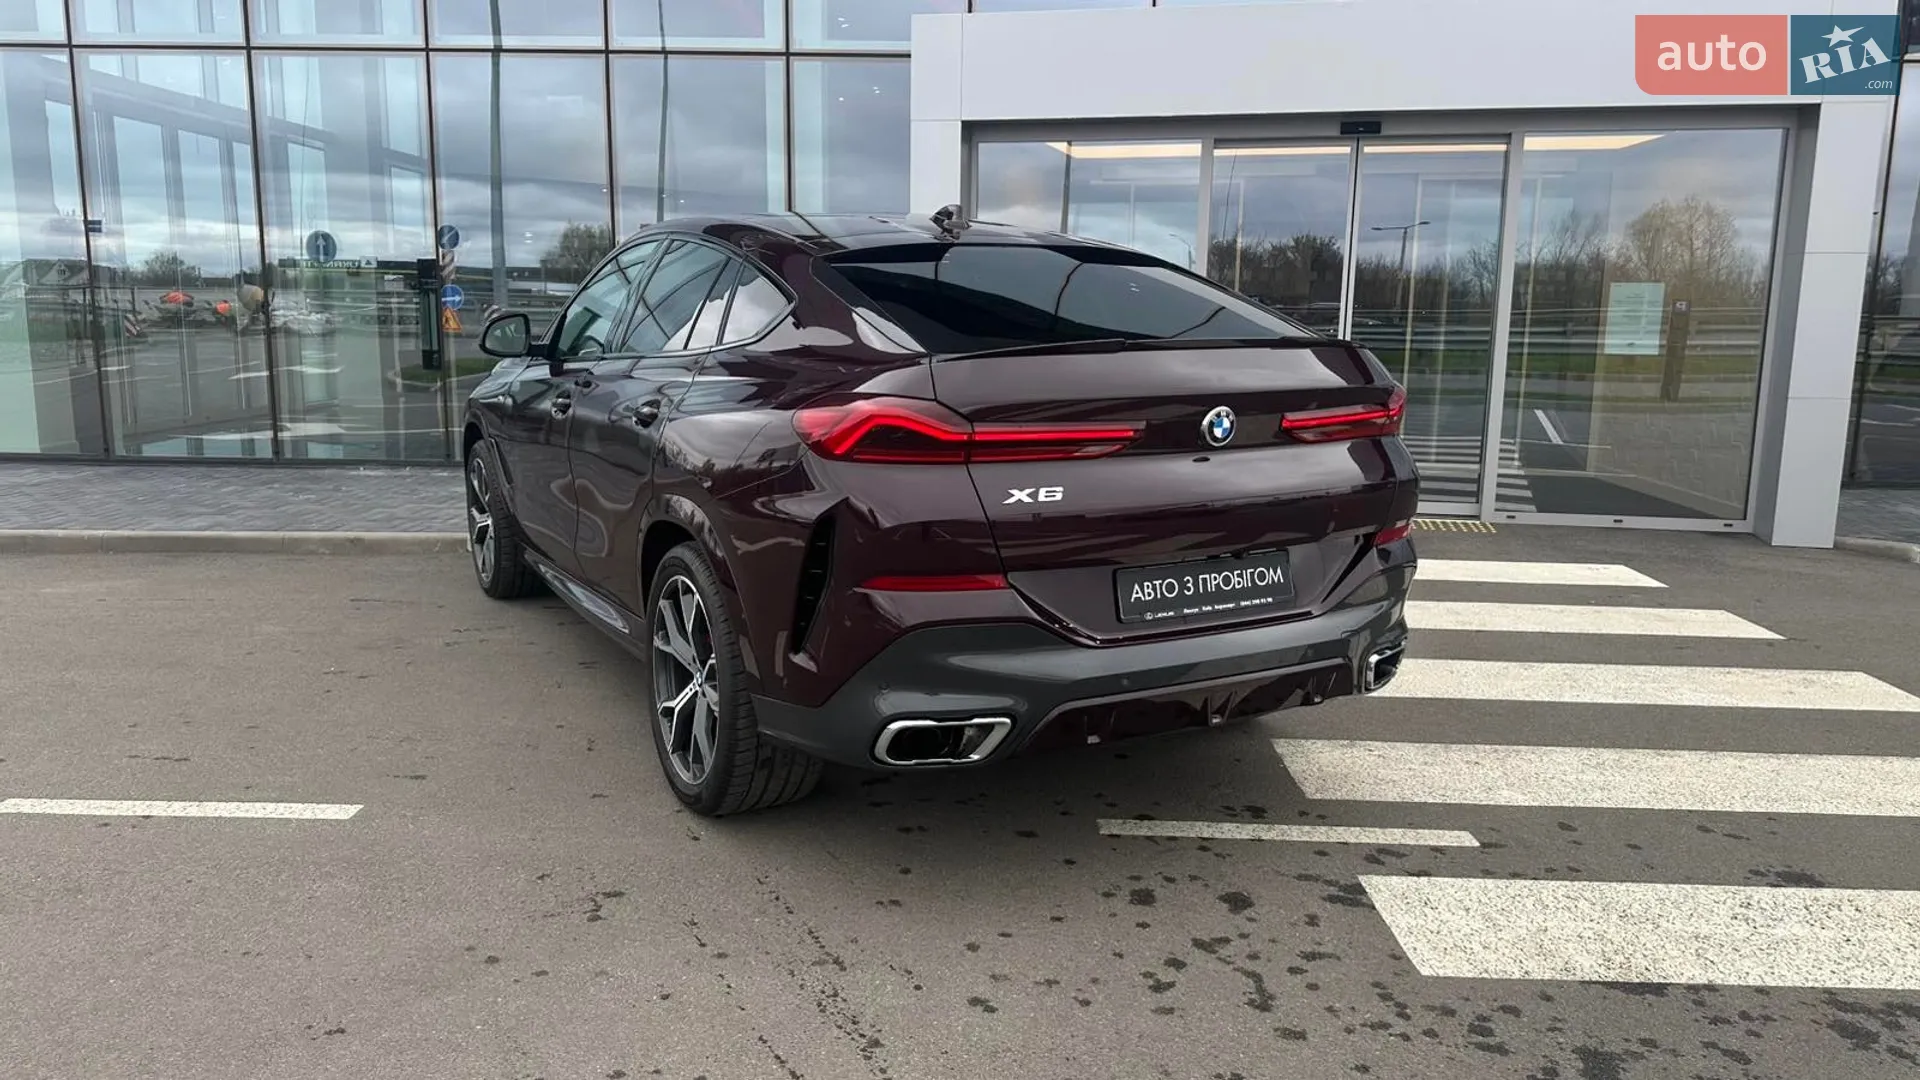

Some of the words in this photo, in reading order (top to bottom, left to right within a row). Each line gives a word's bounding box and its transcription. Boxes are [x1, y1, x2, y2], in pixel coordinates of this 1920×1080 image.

[1002, 486, 1064, 504] X6
[1130, 578, 1179, 603] АВТО
[1198, 566, 1284, 594] ПРОБІГОМ
